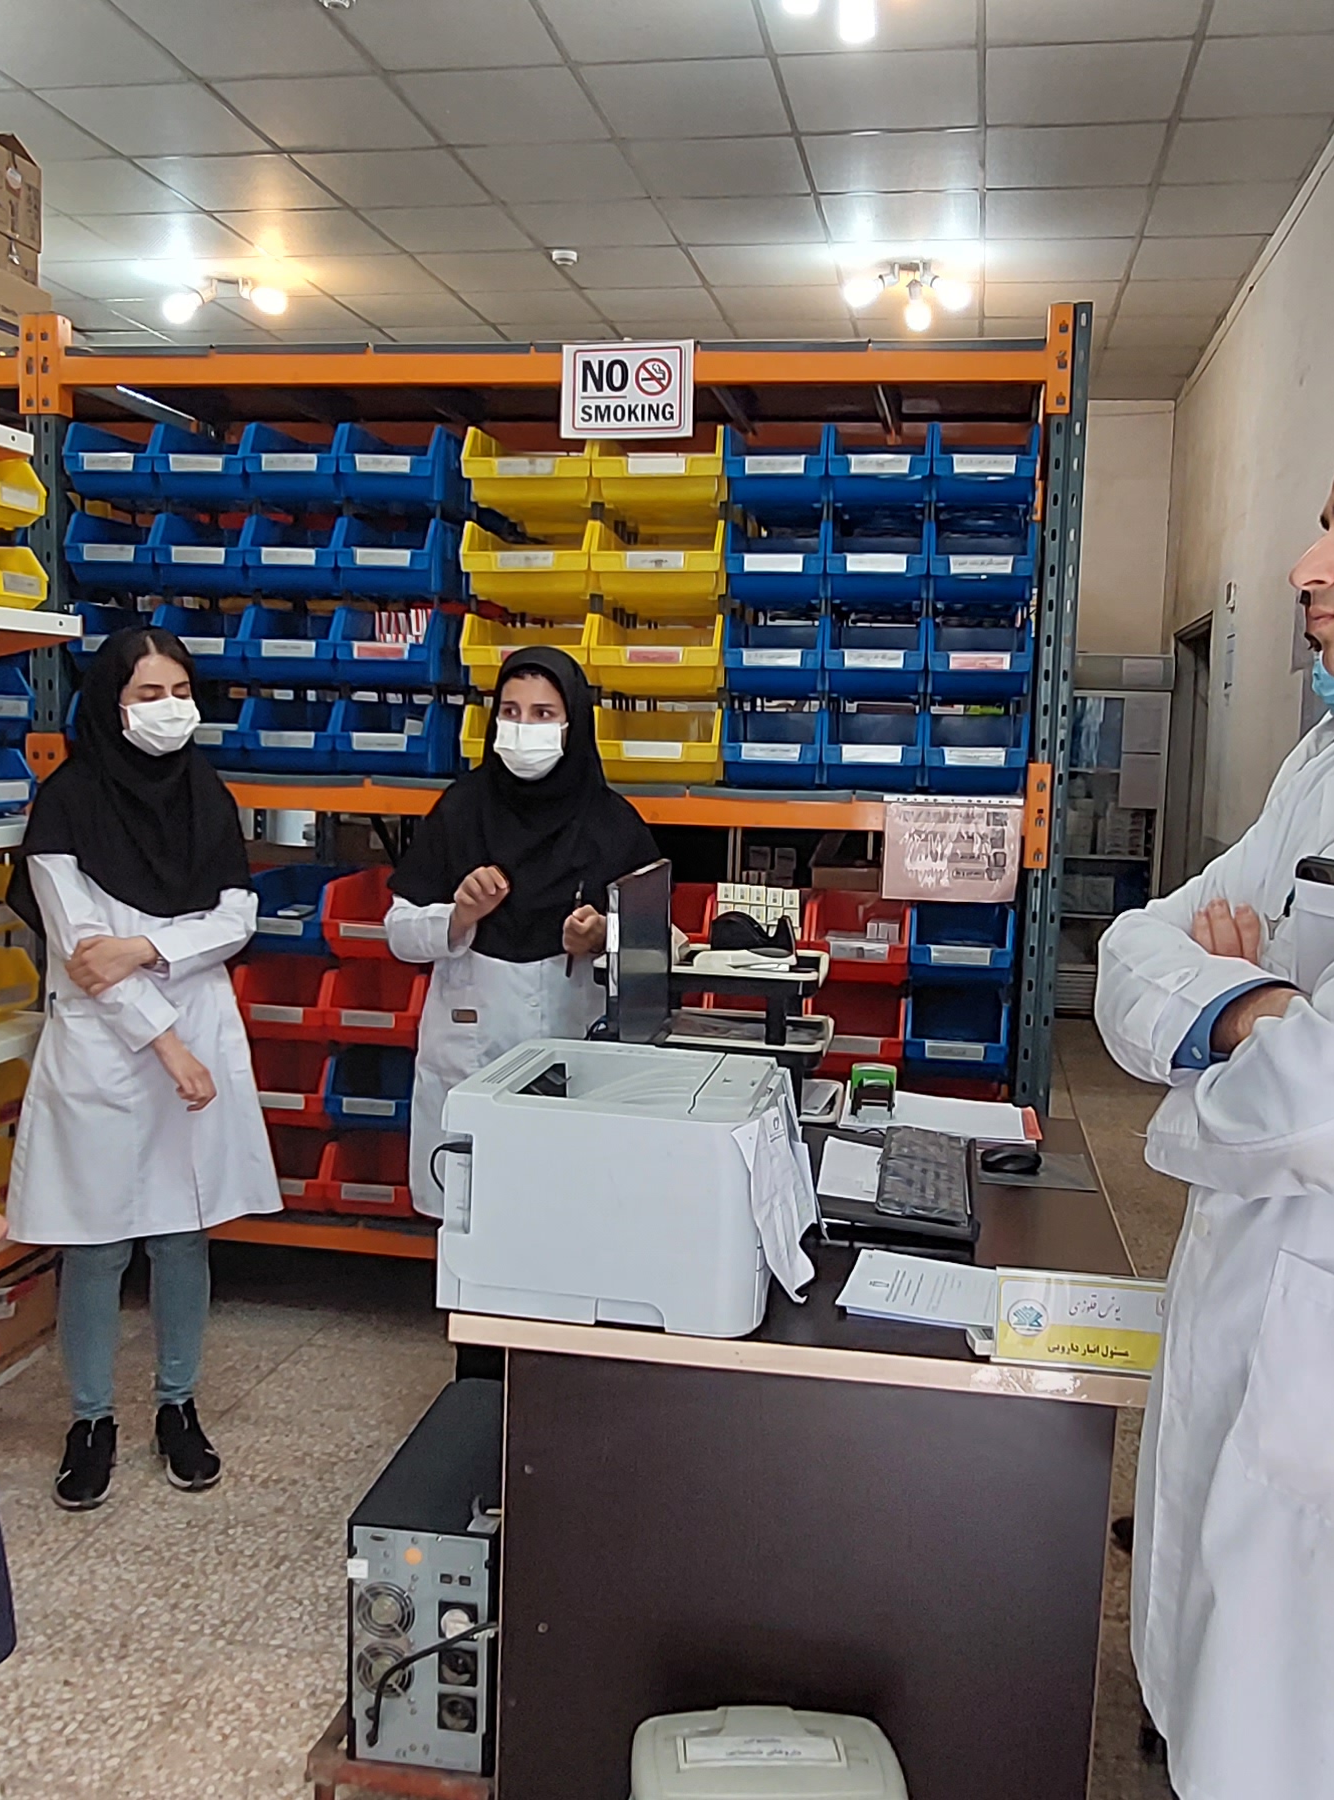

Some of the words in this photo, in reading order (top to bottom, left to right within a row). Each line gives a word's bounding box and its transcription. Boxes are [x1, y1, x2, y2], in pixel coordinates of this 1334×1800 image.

[581, 358, 629, 393] NO
[580, 402, 675, 423] SMOKING
[1081, 1342, 1100, 1358] انبار
[1101, 1344, 1130, 1359] مسئول
